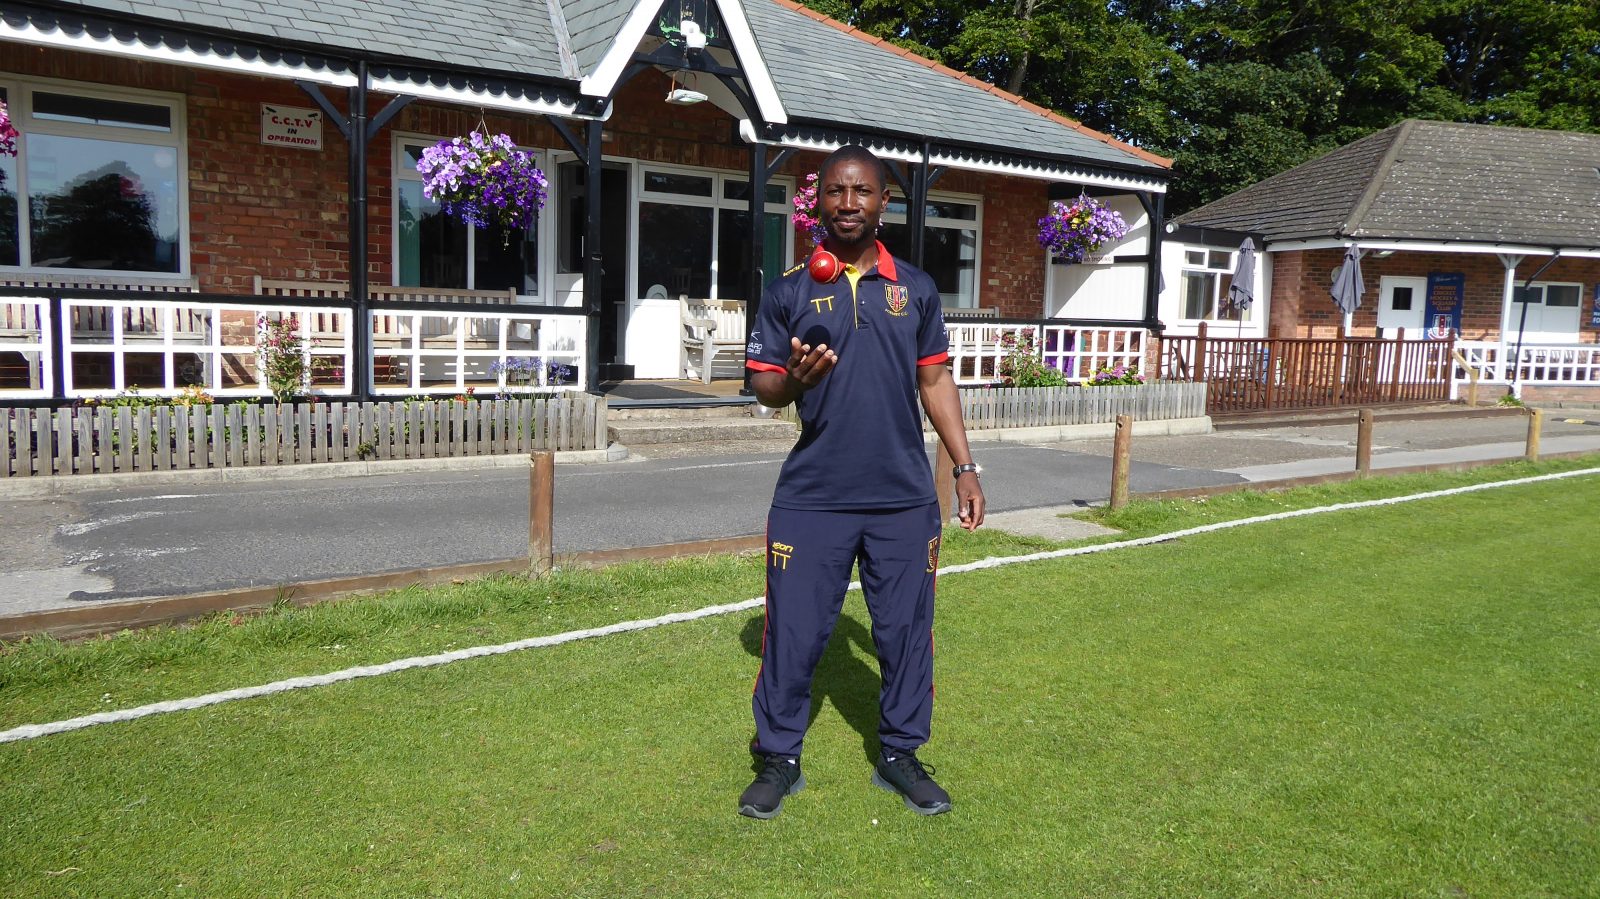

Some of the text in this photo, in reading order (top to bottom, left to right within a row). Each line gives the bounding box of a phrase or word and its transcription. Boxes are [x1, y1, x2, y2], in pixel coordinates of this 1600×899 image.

[271, 115, 313, 128] C.C.T.V
[267, 134, 318, 145] OPERATION
[810, 295, 835, 313] TT
[771, 550, 791, 570] TT
